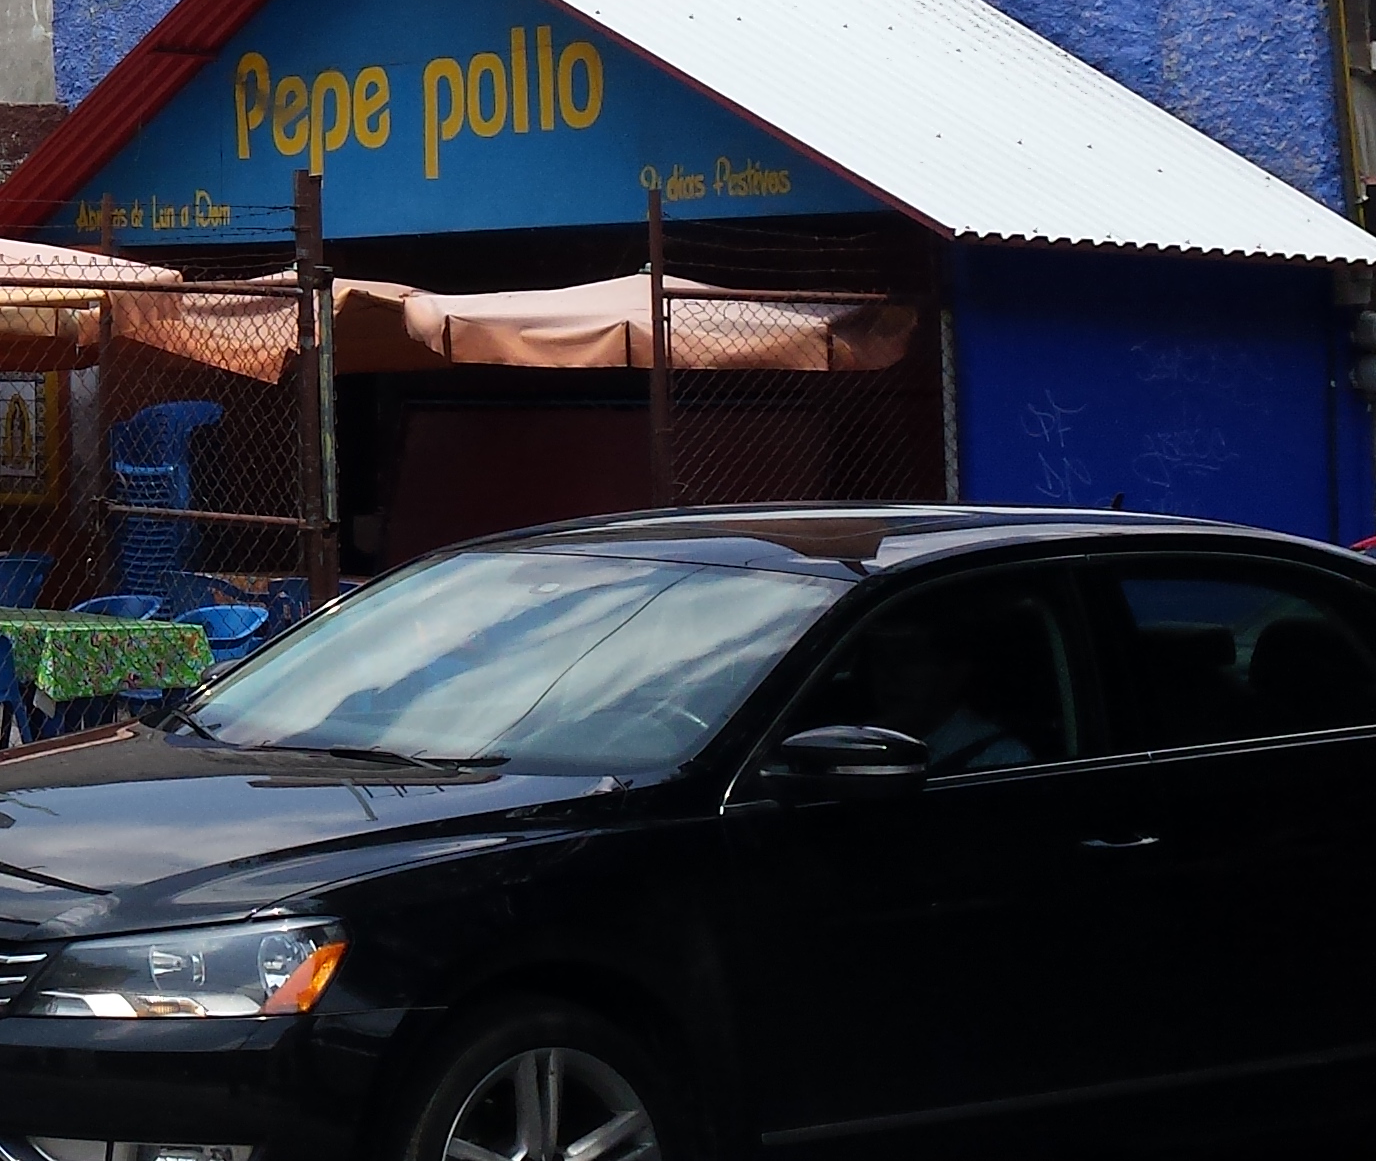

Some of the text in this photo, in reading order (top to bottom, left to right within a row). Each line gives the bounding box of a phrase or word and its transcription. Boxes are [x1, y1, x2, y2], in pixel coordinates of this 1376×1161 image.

[234, 25, 604, 180] Pepe pollo
[152, 195, 176, 232] Lun
